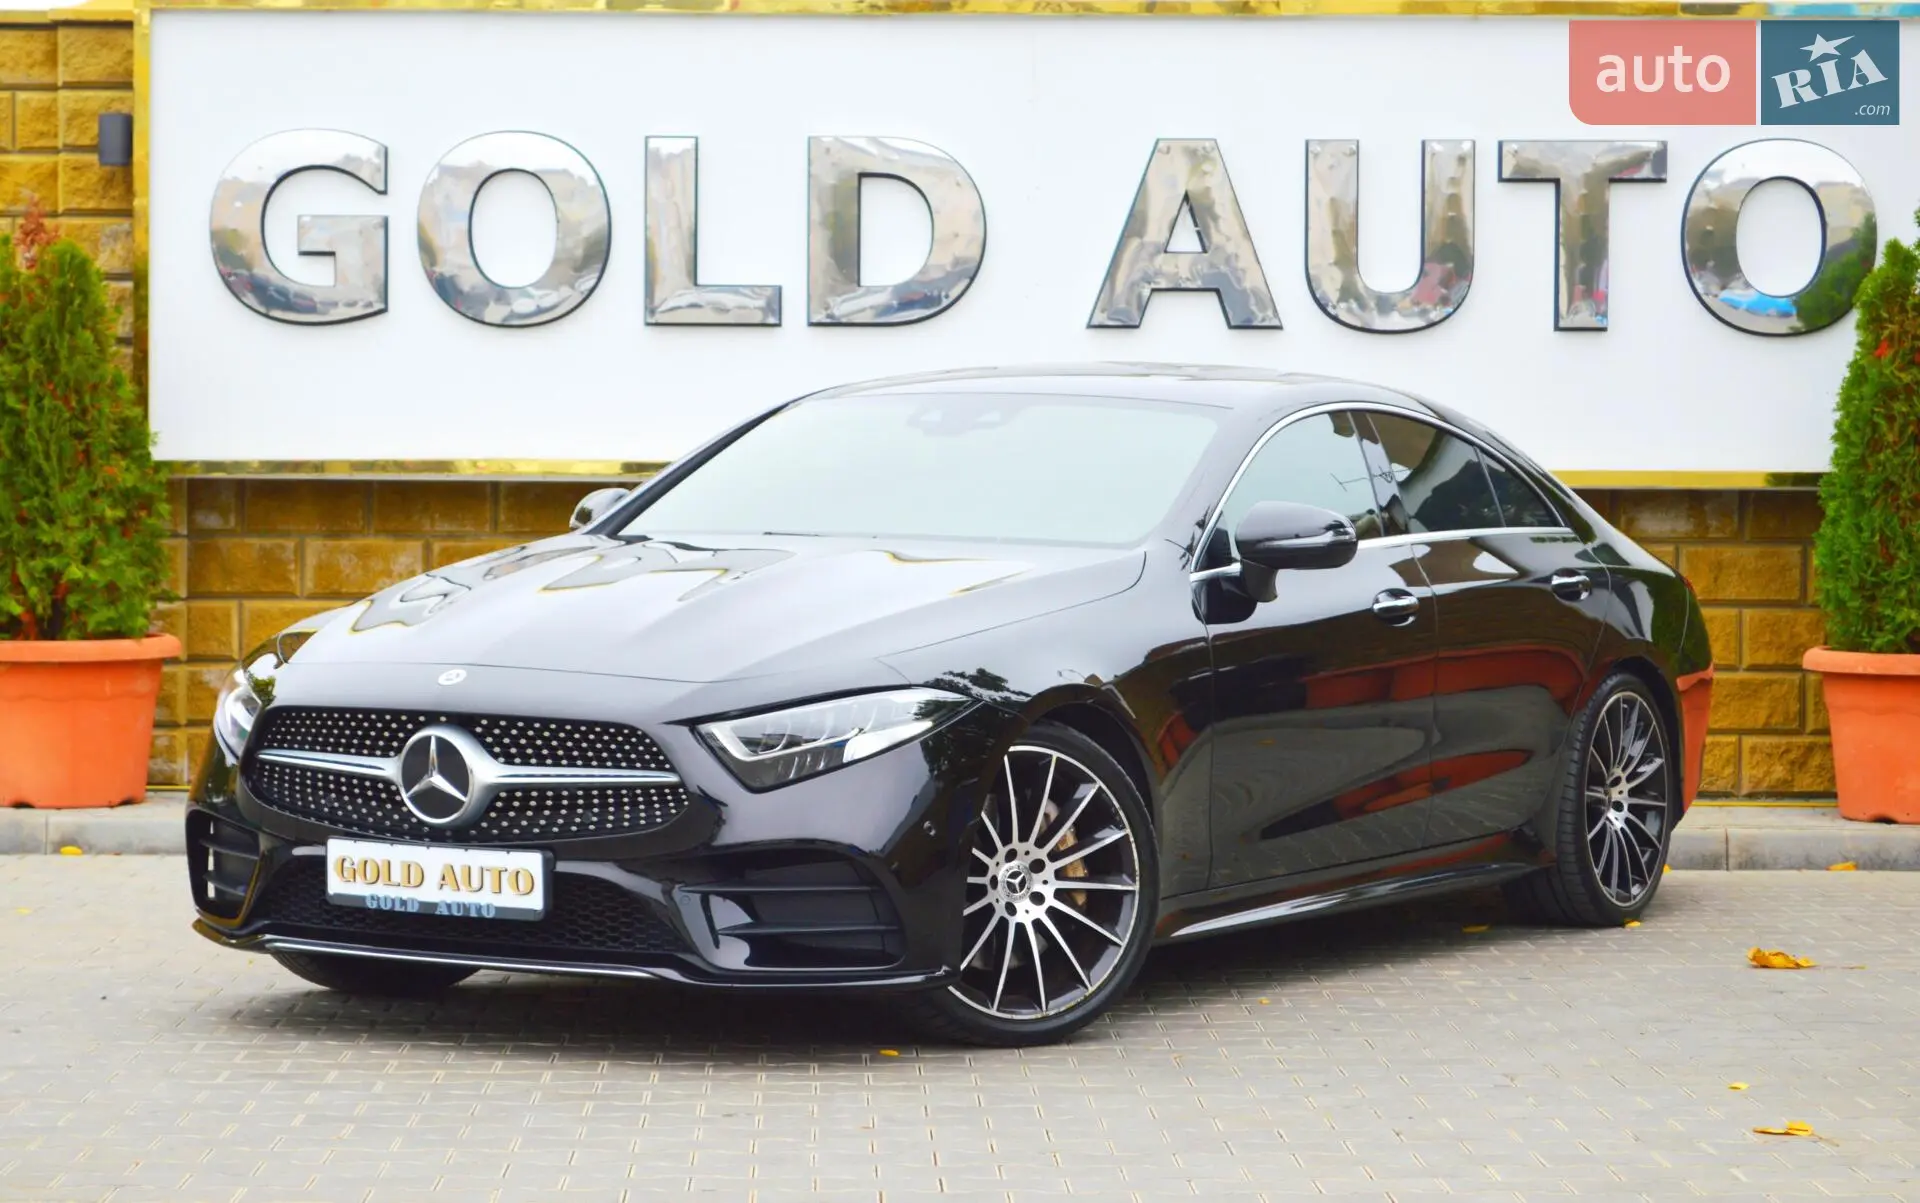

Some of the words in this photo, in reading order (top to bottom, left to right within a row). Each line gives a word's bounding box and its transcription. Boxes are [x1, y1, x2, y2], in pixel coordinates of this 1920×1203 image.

[209, 128, 987, 327] GOLD
[1086, 137, 1878, 337] AUTO
[333, 854, 425, 888] GOLD
[438, 863, 535, 896] AUTO
[365, 893, 420, 913] GOLD
[434, 901, 497, 918] AUTO
